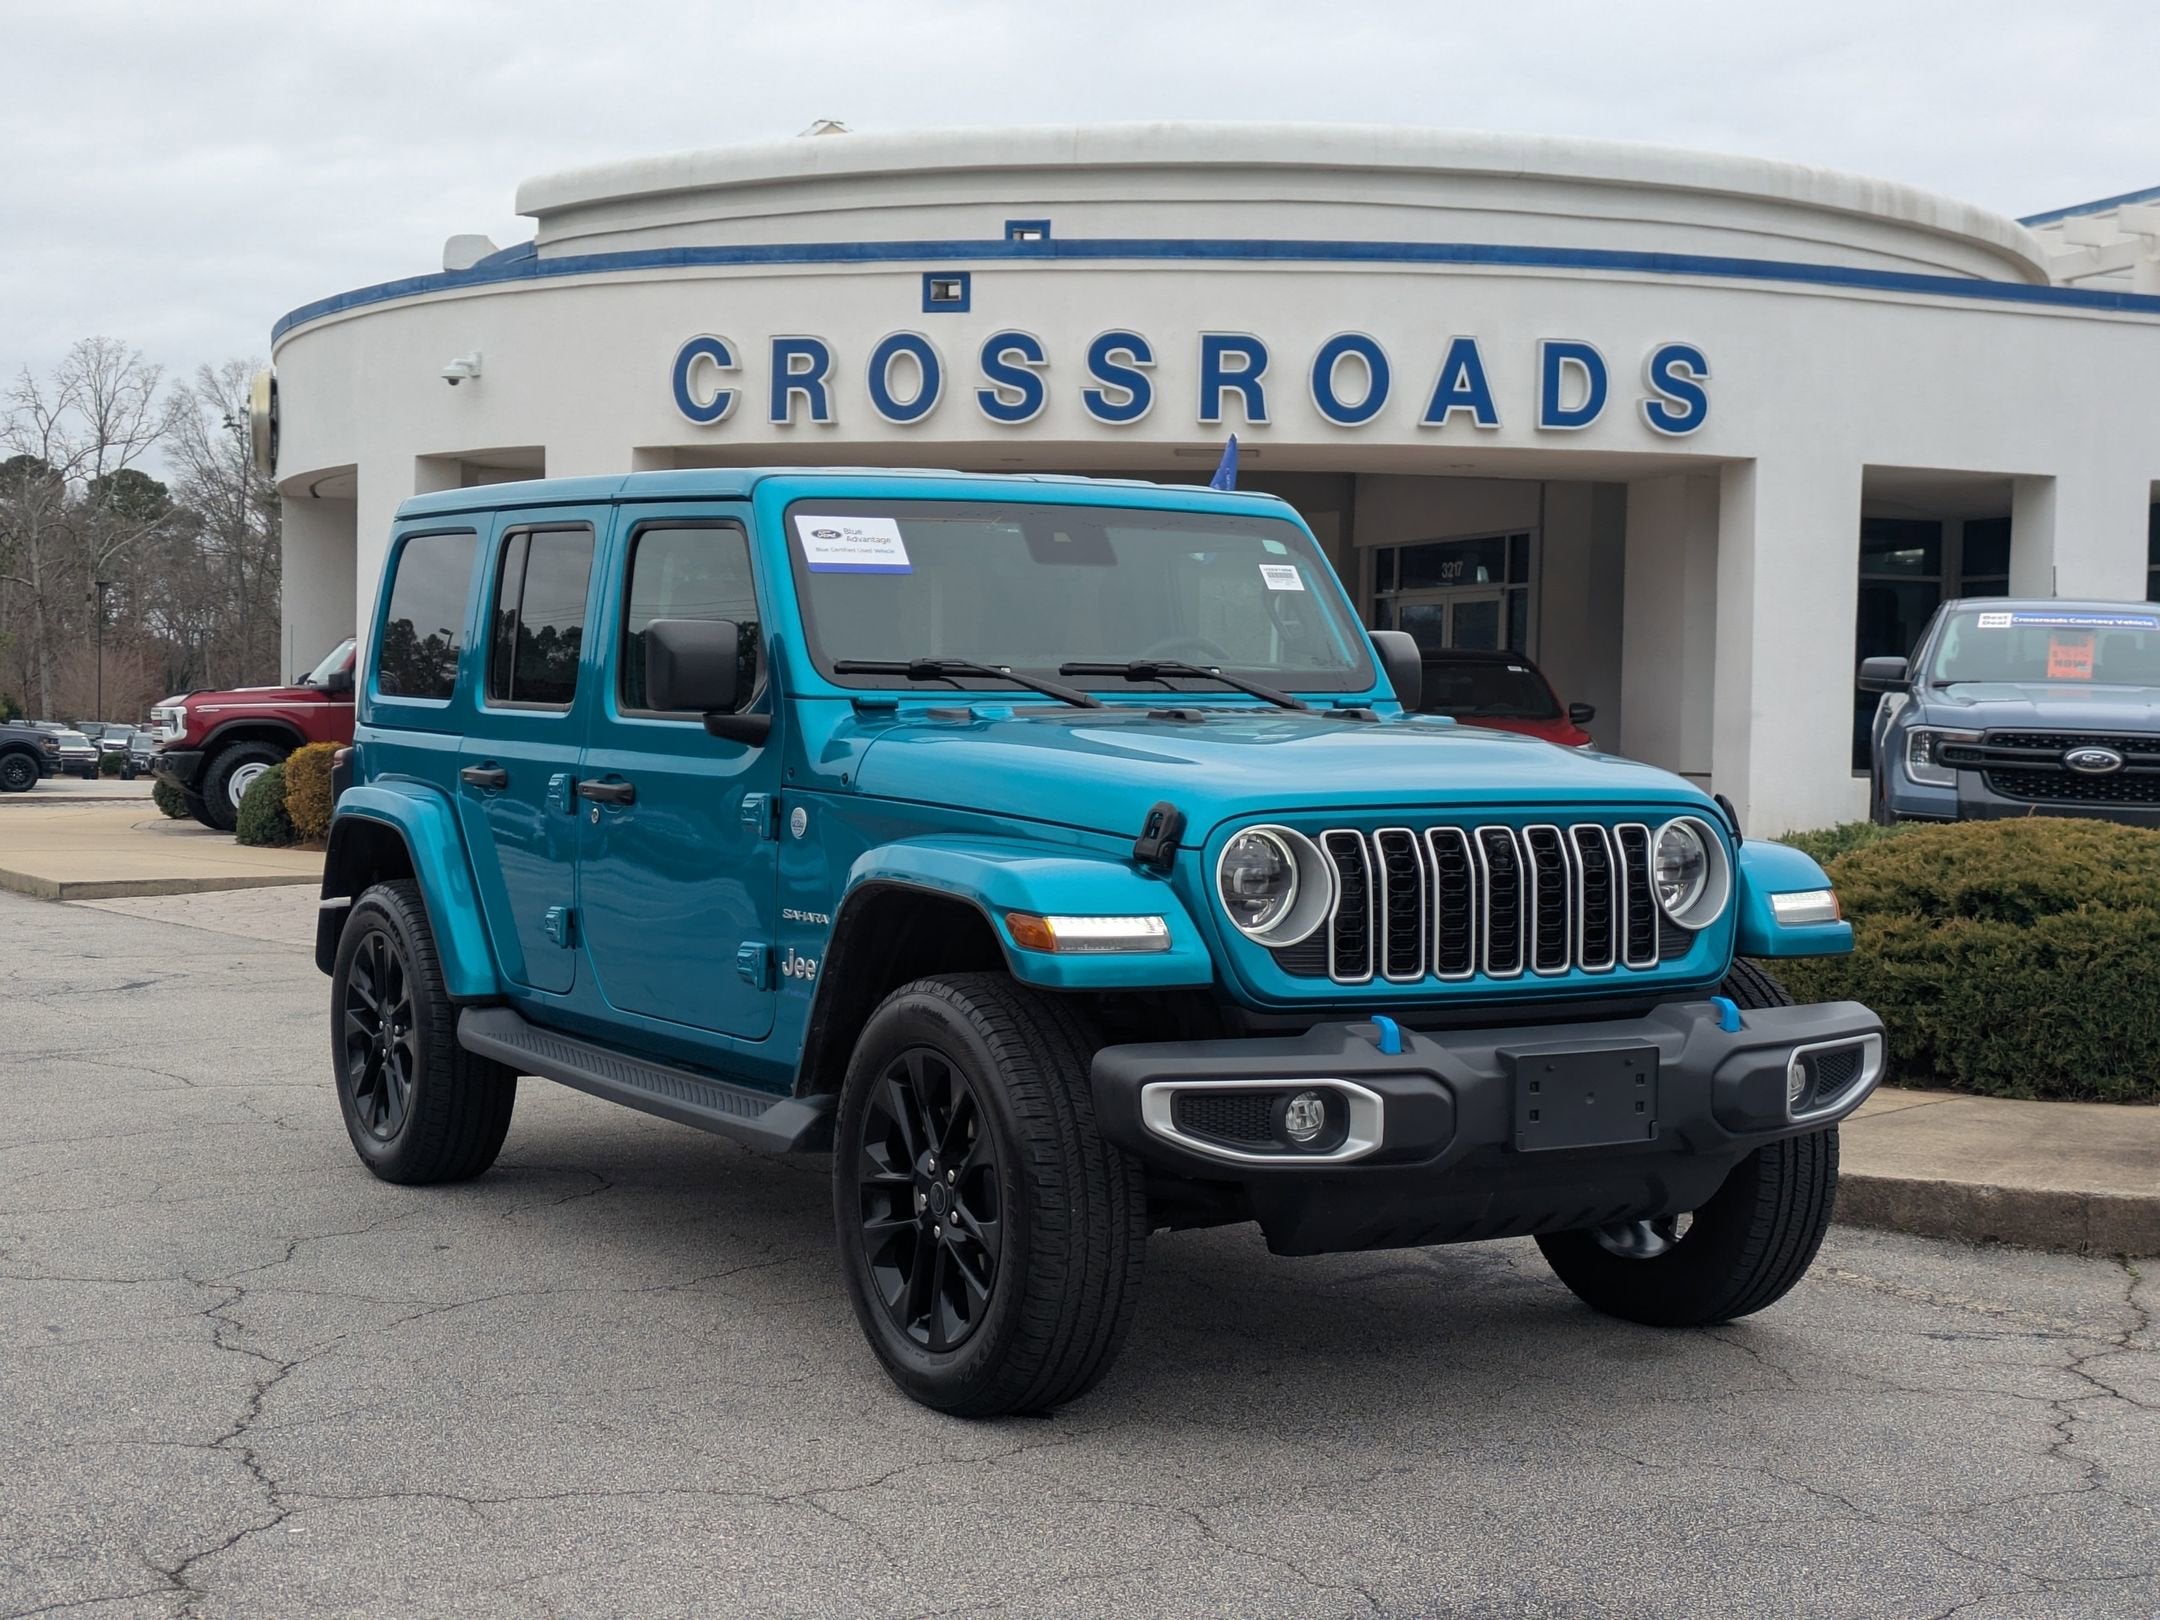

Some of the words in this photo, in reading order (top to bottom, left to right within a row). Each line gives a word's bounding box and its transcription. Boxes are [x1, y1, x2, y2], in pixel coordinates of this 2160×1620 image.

[671, 329, 1711, 437] CROSSROADS
[846, 536, 892, 545] Advantage
[1441, 561, 1464, 578] 3217
[2012, 616, 2068, 624] Crossroads
[782, 908, 829, 925] SAHARA
[782, 948, 819, 981] Jee
